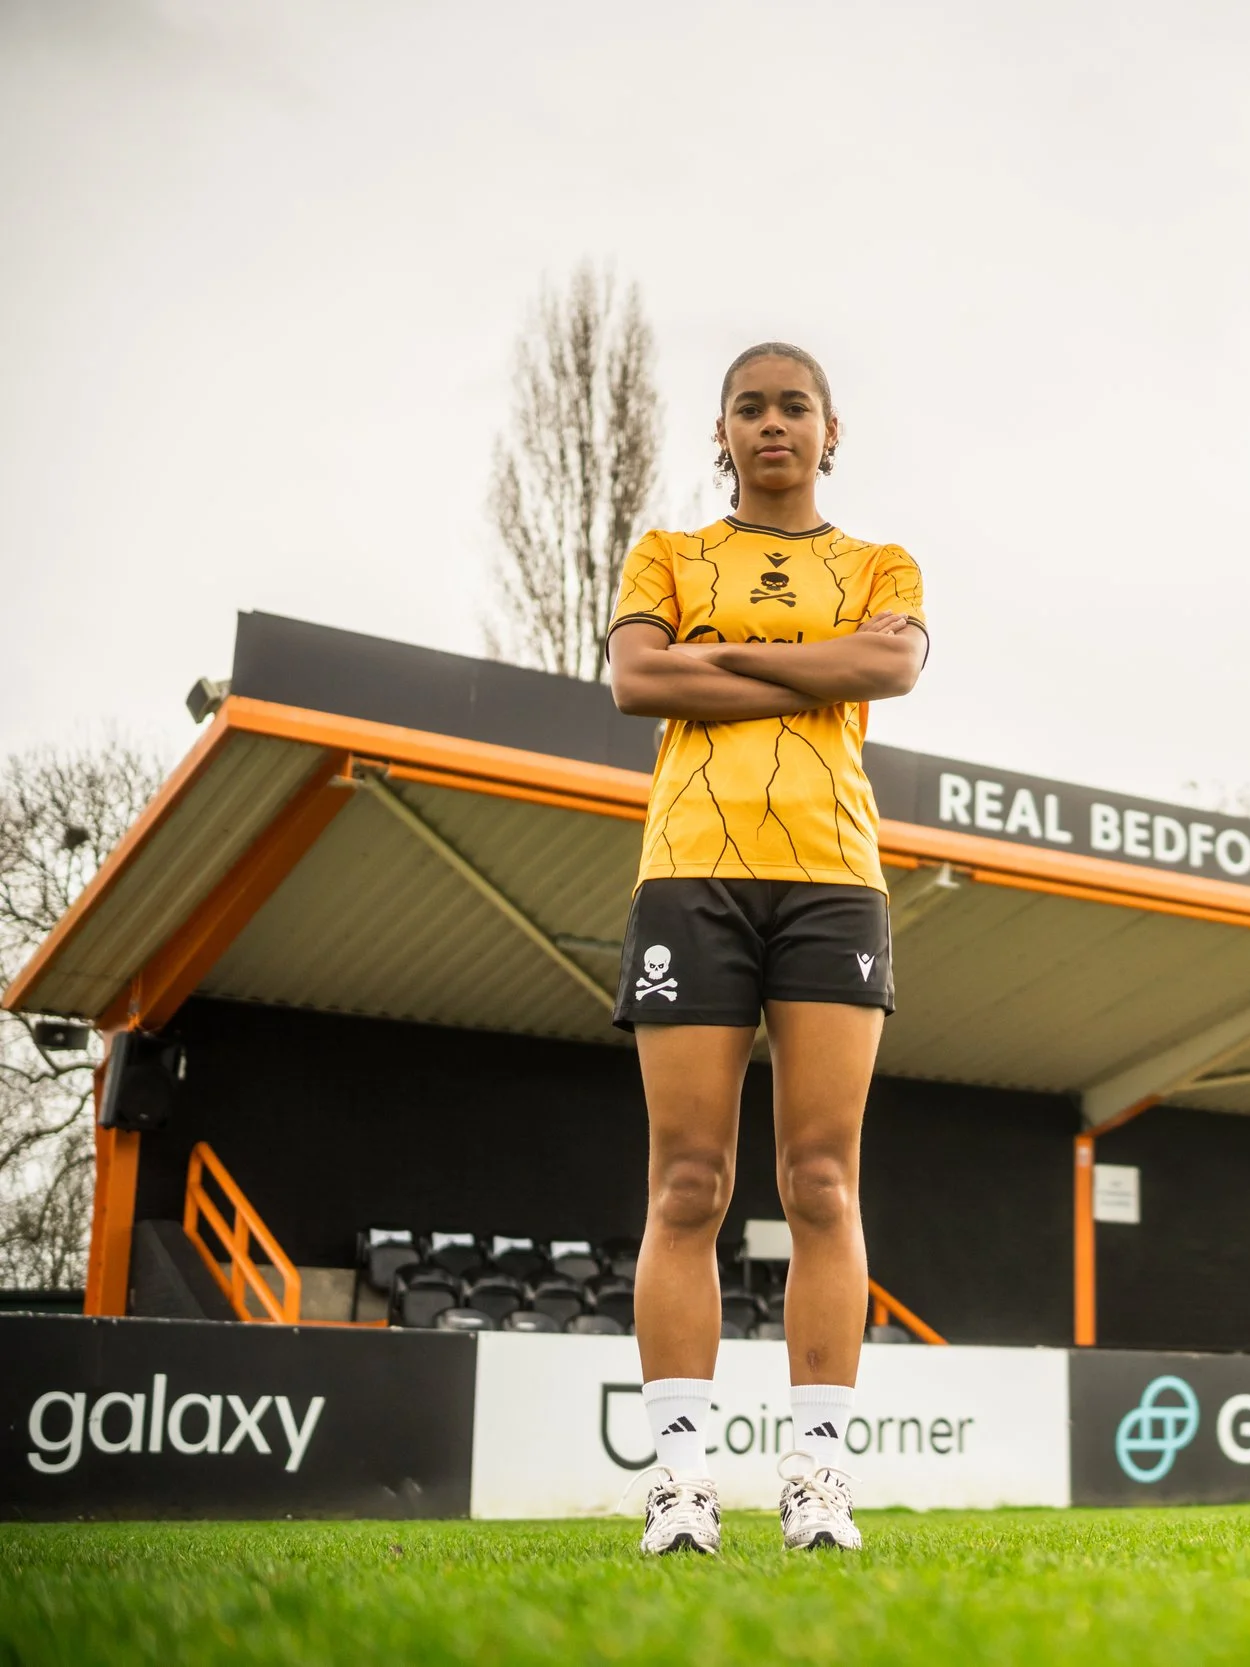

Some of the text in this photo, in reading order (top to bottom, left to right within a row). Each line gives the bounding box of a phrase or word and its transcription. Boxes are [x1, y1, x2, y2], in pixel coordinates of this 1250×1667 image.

[939, 772, 1073, 844] REAL
[28, 1373, 326, 1474] galaxy
[705, 1402, 975, 1455] oinorner
